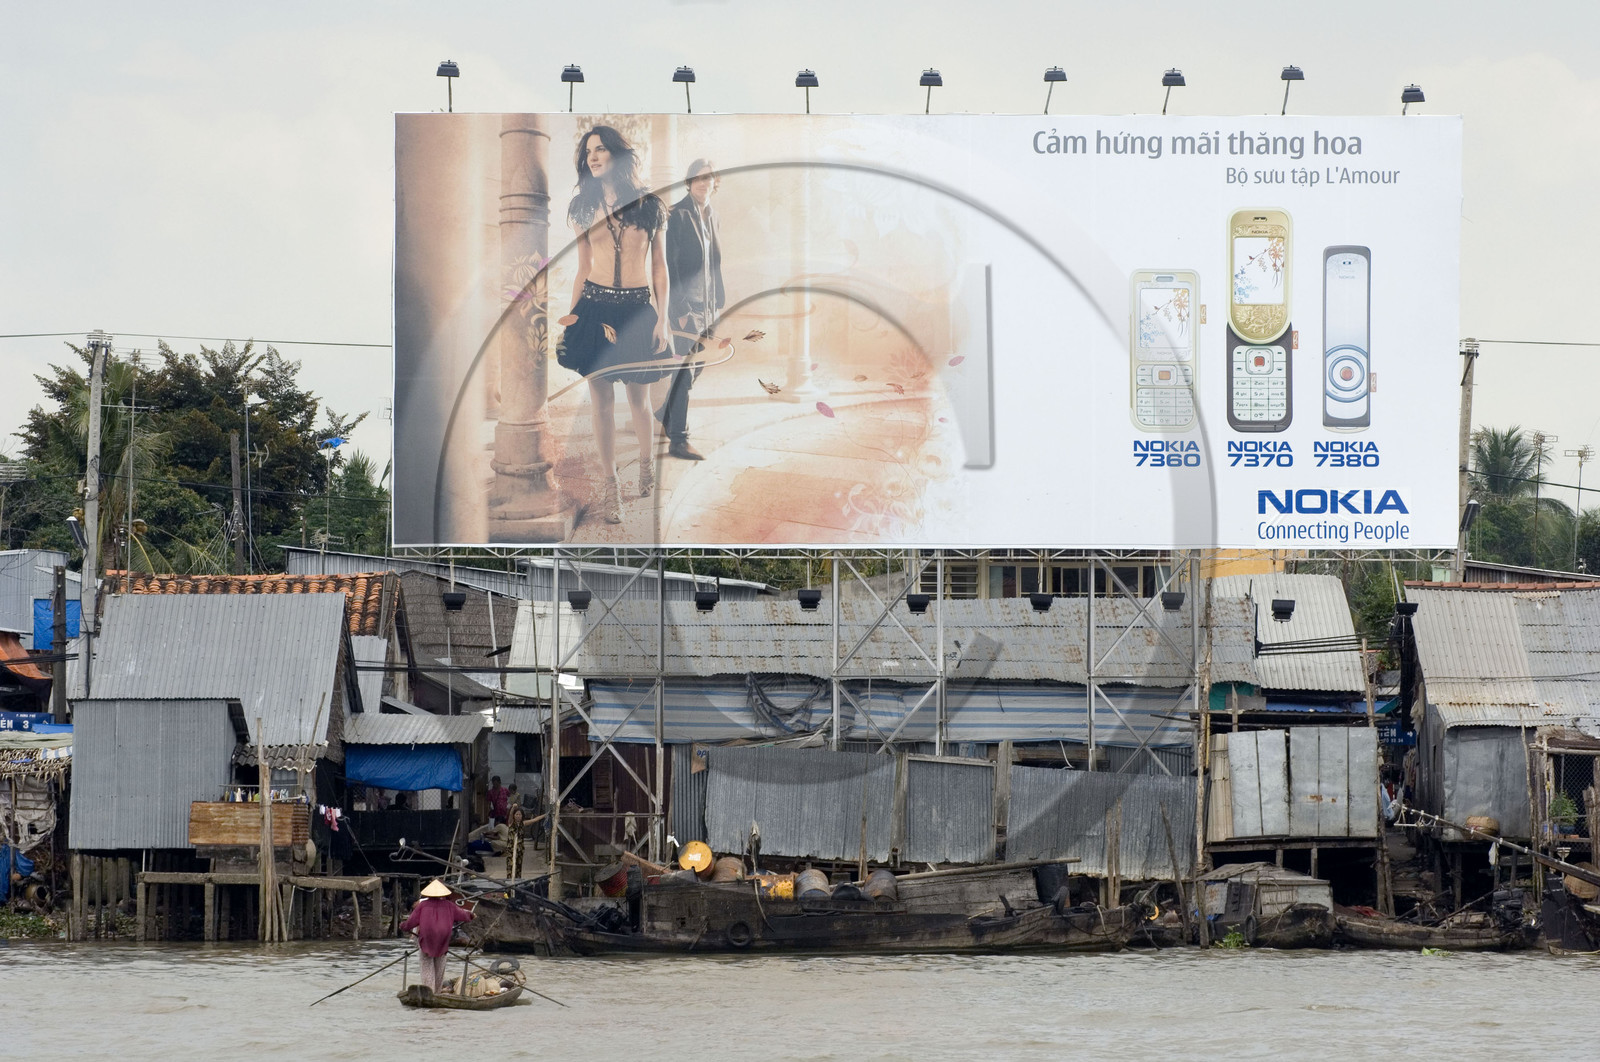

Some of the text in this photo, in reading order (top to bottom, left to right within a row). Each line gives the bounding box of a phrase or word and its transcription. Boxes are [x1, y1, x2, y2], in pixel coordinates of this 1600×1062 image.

[1032, 127, 1362, 159] Cảm hứng mãi thăng hoa
[1226, 166, 1400, 187] Bộ sưu tập L'Amour
[1133, 440, 1200, 452] NOKIA
[1227, 440, 1293, 452] NOKIA
[1313, 440, 1379, 452] NOKIA
[1133, 453, 1201, 467] 7360
[1228, 453, 1293, 467] 7370
[1314, 453, 1380, 467] 7380
[1257, 489, 1410, 514] NOKIA
[1257, 521, 1410, 544] Connecting People
[22, 720, 29, 729] 3
